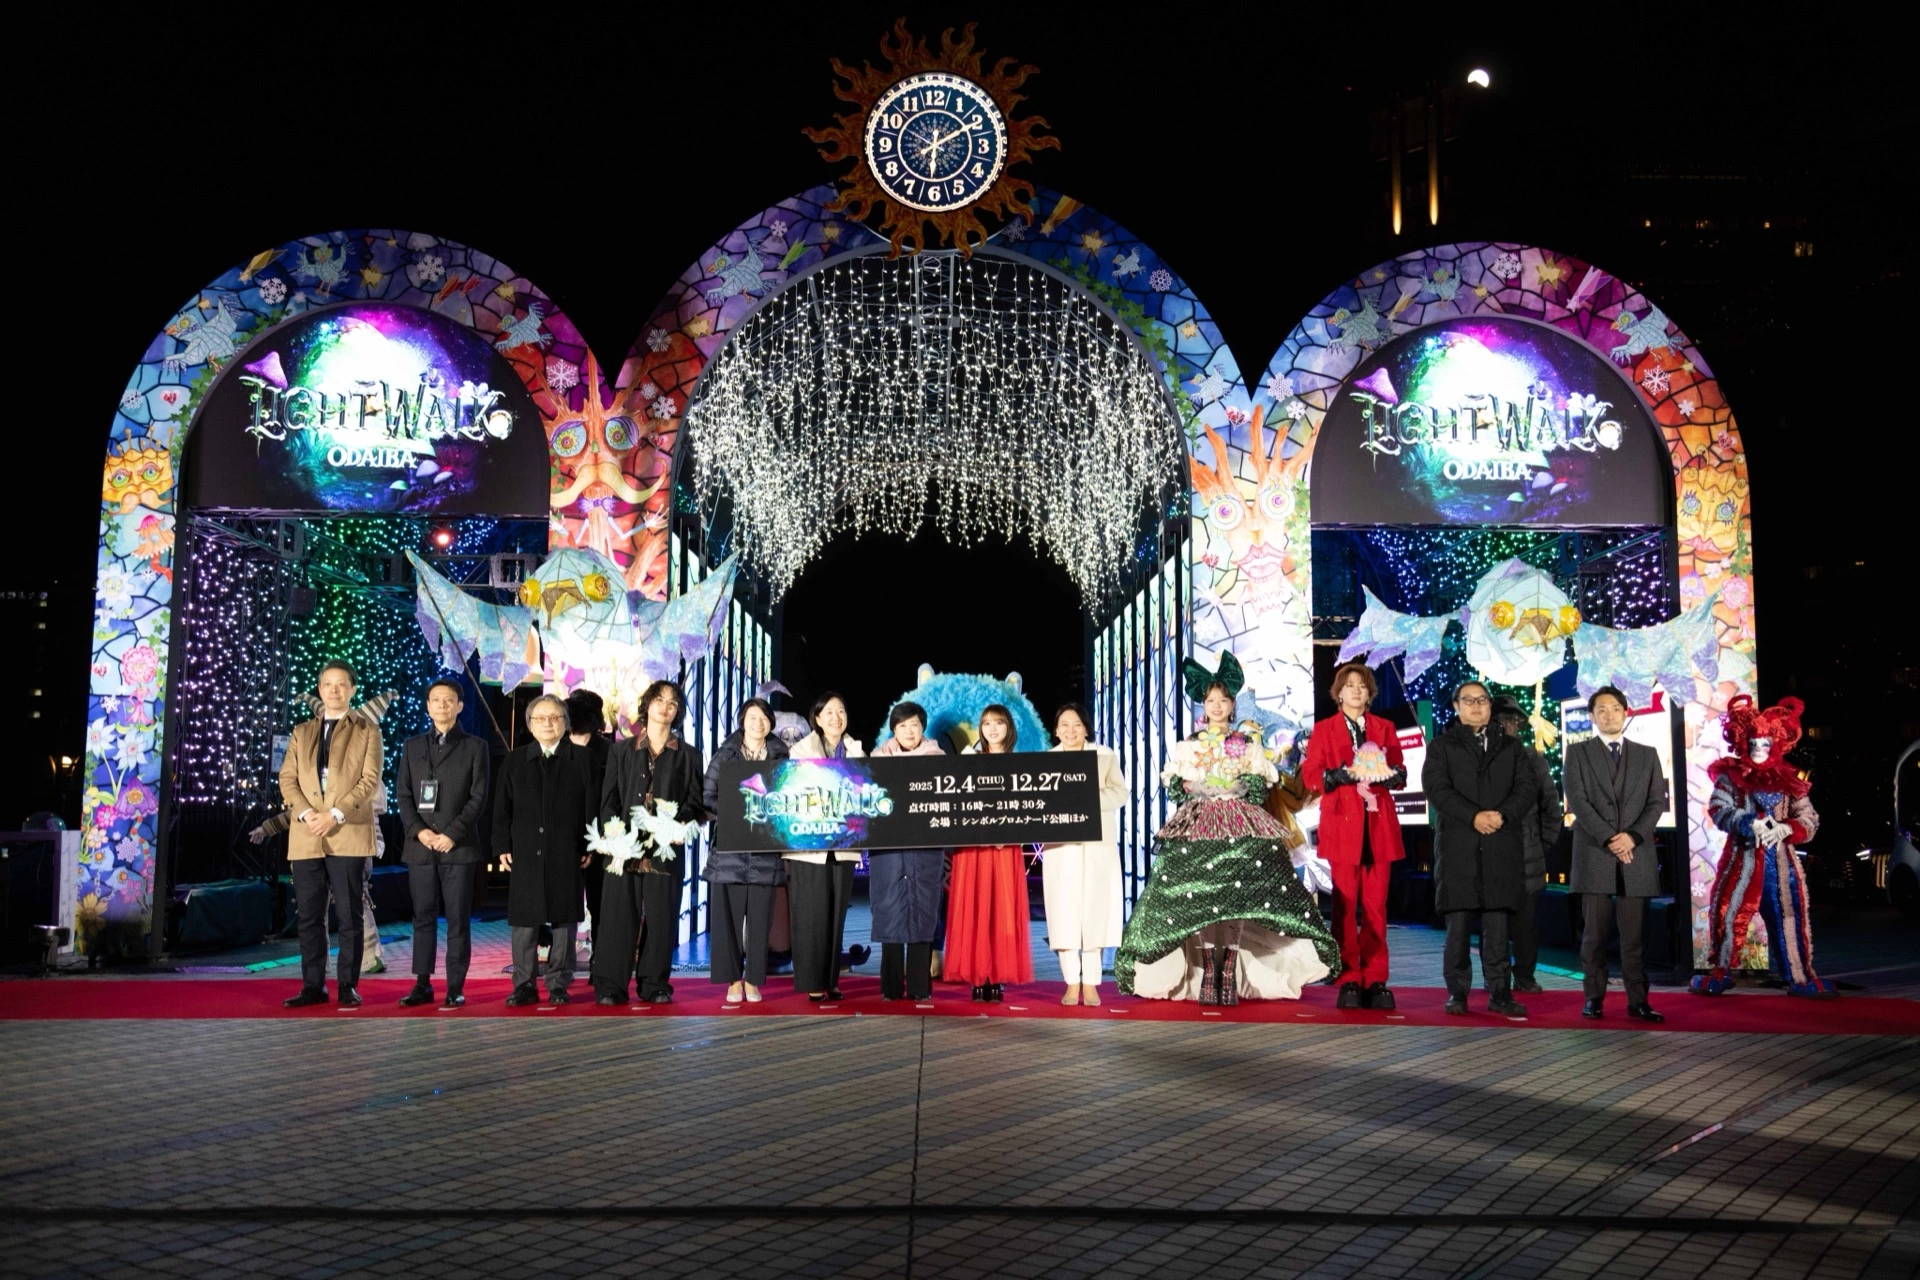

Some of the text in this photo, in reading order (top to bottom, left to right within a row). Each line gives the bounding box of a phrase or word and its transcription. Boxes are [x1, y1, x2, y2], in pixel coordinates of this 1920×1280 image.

[903, 97, 919, 112] 11
[925, 91, 945, 106] 12
[956, 97, 964, 112] 1
[882, 114, 903, 129] 10
[972, 115, 983, 130] 2
[879, 137, 892, 153] 9
[978, 138, 990, 154] 3
[885, 161, 898, 177] 8
[971, 163, 984, 178] 4
[904, 179, 916, 195] 7
[928, 186, 941, 201] 6
[953, 180, 965, 195] 5
[327, 446, 418, 468] ODAIBA
[1443, 460, 1533, 481] ODAIBA
[909, 772, 1087, 794] 2025 12.4 (THU) 12.27 (SAT)
[790, 823, 841, 834] ODAIBA
